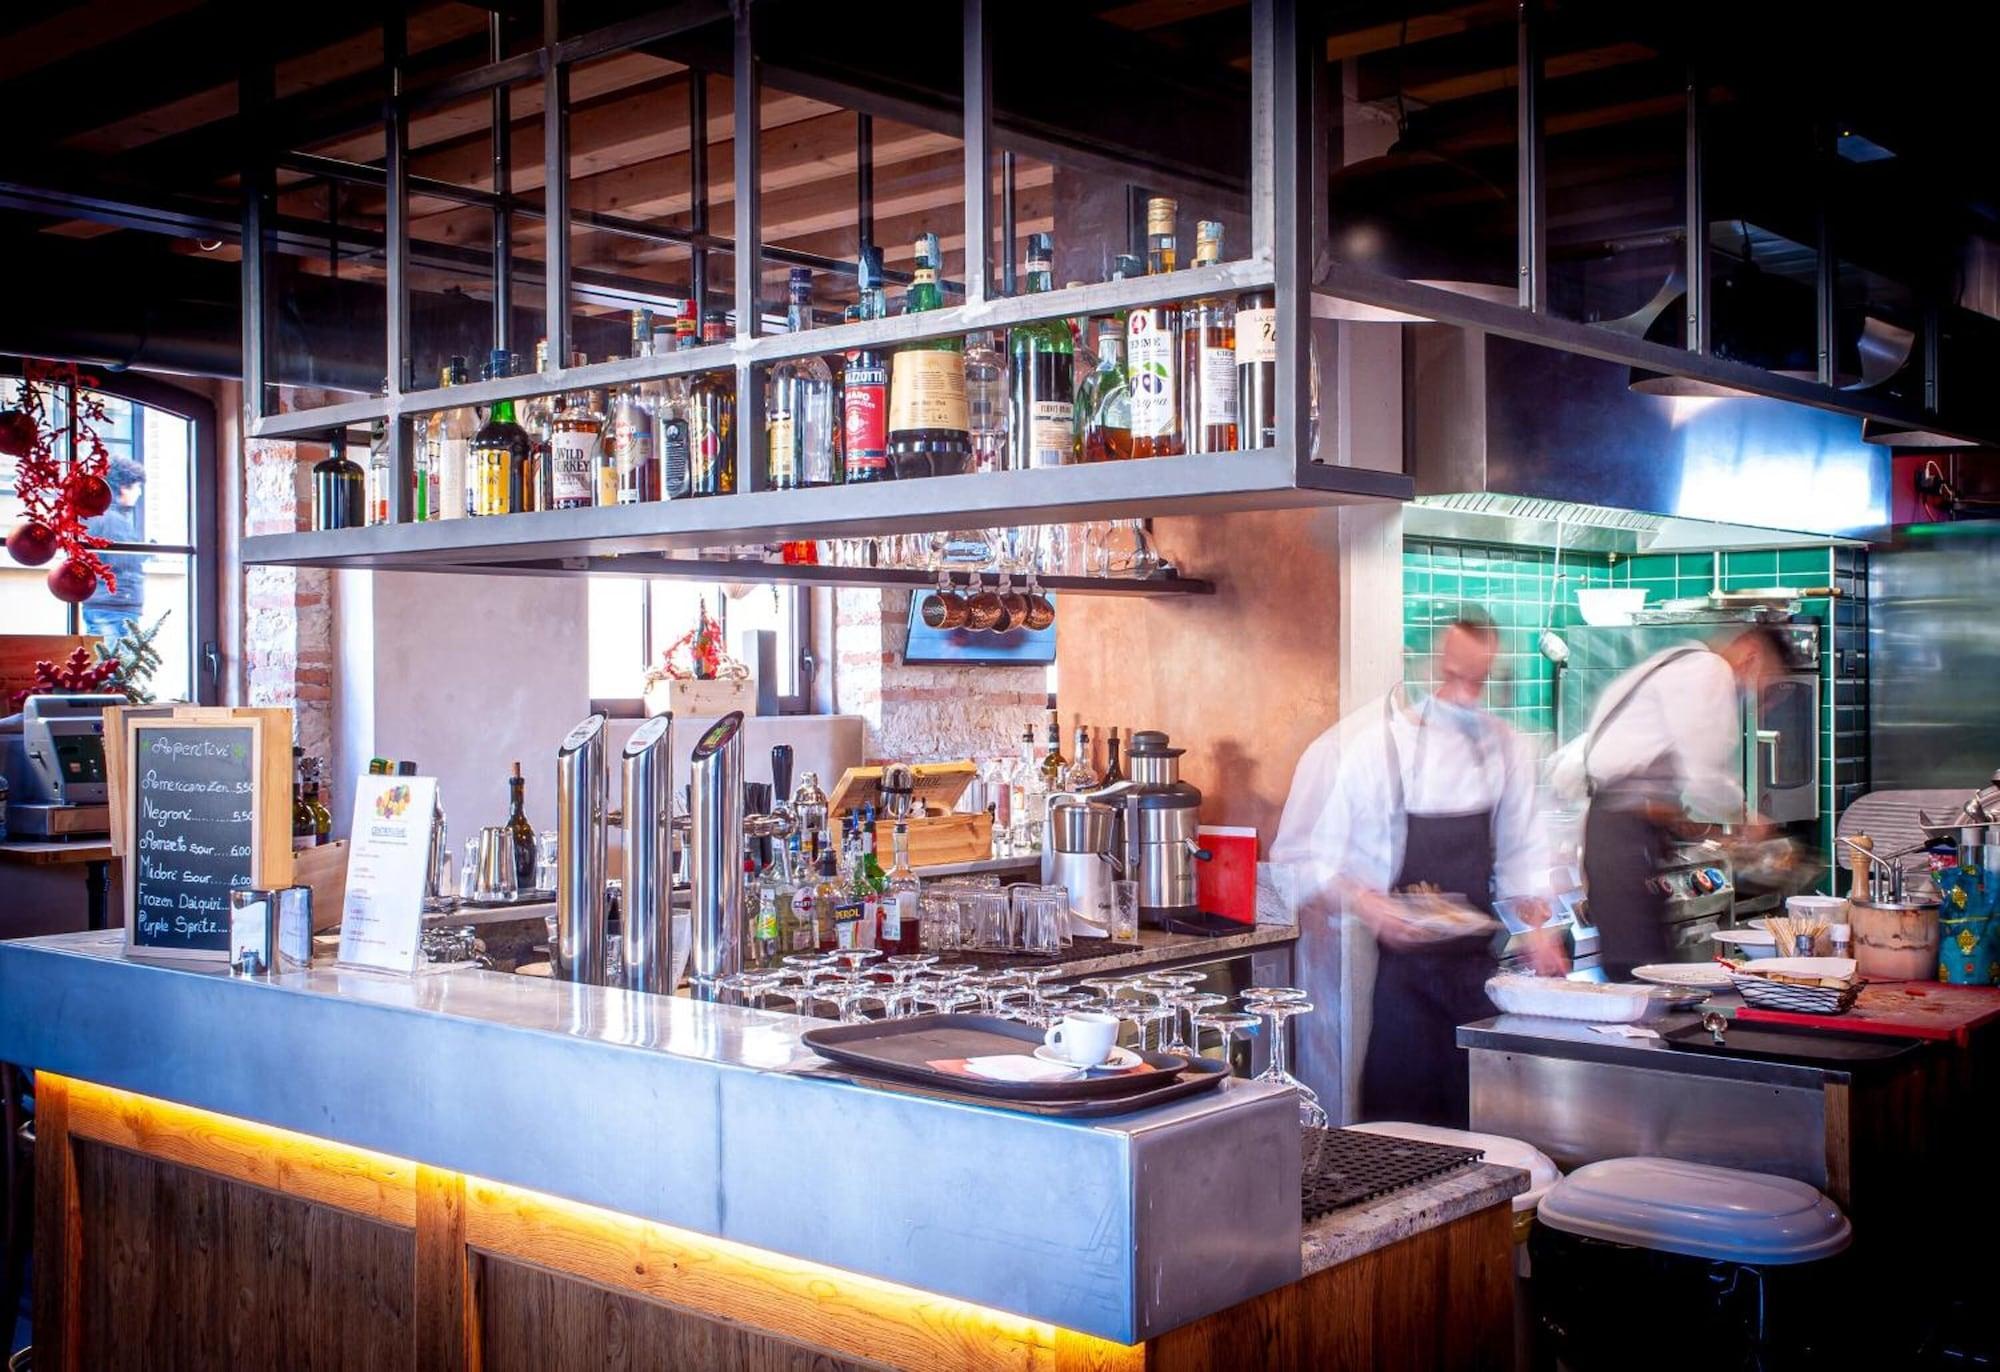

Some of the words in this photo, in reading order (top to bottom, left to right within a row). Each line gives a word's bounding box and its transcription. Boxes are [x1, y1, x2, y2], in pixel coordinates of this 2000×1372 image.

[554, 447, 584, 460] WILD
[152, 737, 230, 763] Aperitivi
[143, 796, 192, 828] Negroni
[140, 854, 178, 880] Midori
[183, 871, 212, 884] Sour
[139, 882, 173, 907] Frozen
[178, 893, 221, 915] Daiquiri
[138, 910, 169, 938] Purple
[175, 916, 217, 939] Spritz
[835, 908, 861, 919] PEROL
